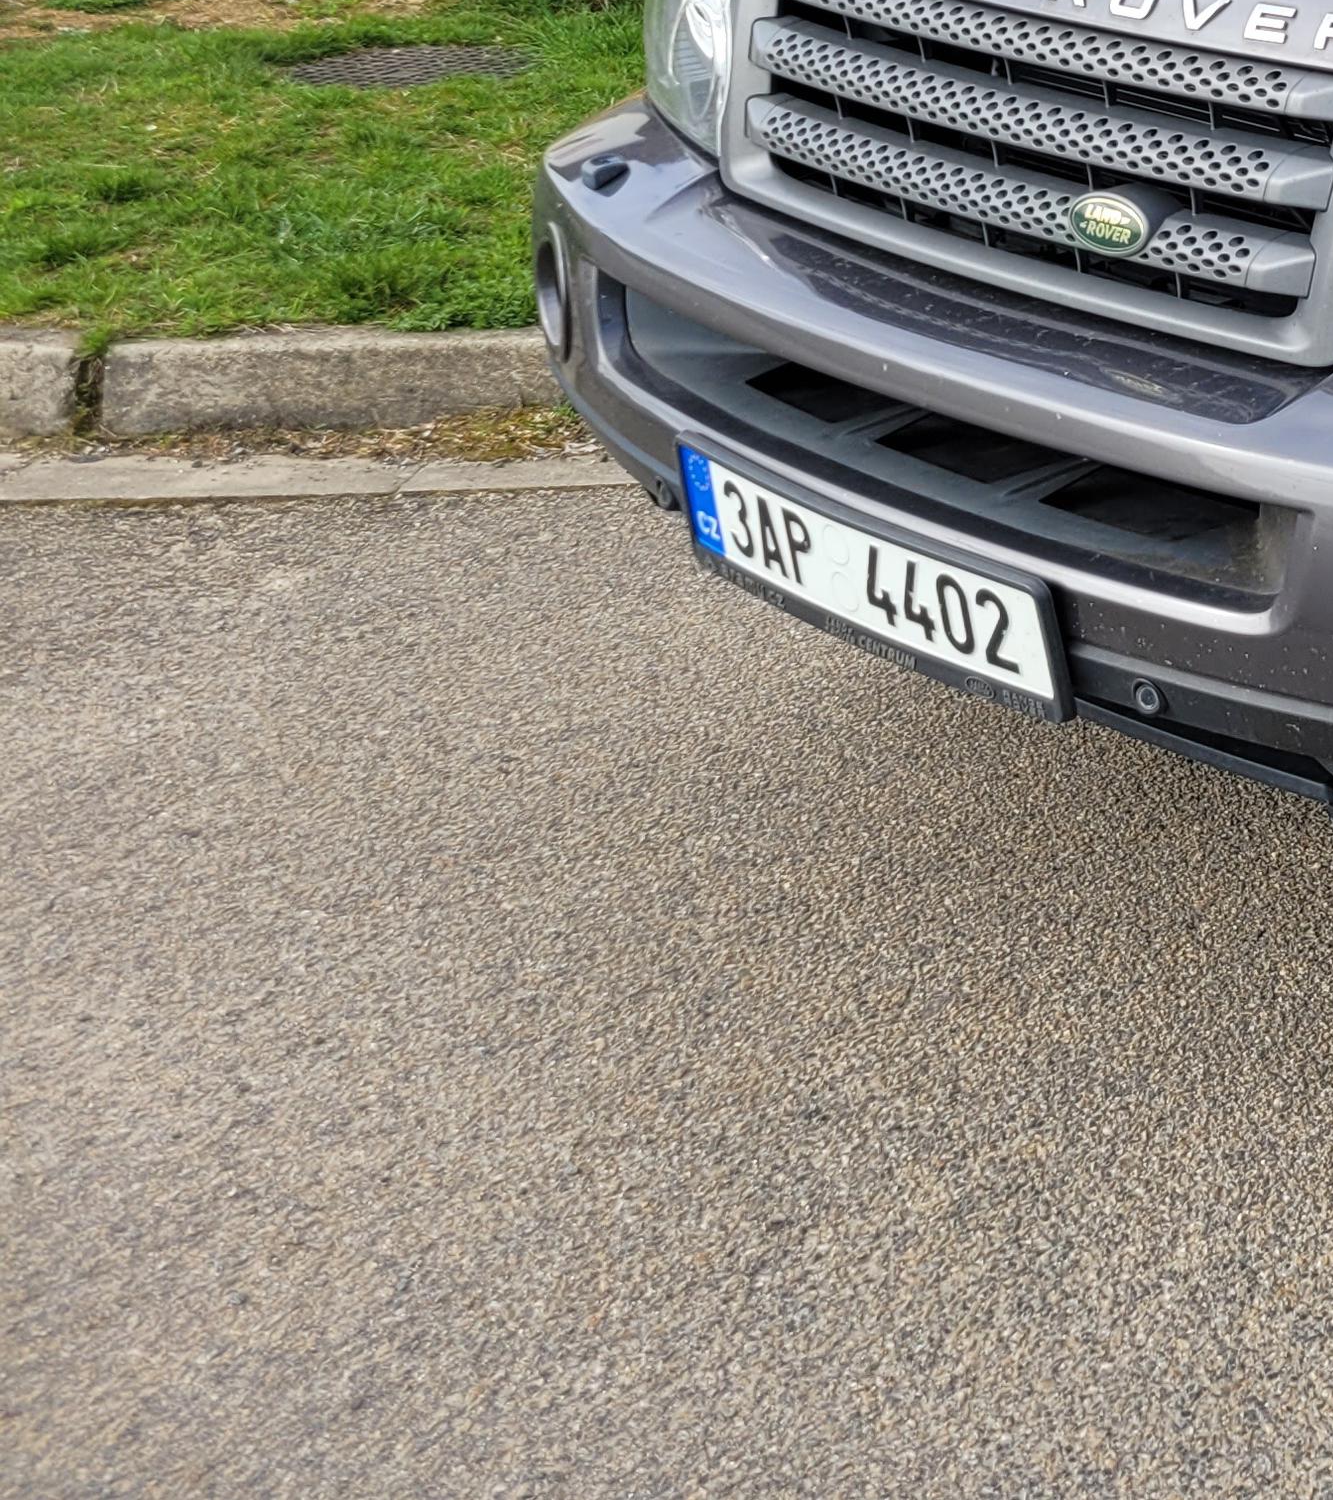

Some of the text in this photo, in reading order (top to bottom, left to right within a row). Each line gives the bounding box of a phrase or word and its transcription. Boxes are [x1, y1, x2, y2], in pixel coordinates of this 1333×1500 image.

[1084, 203, 1122, 225] LAND
[1086, 220, 1132, 245] ROVER
[696, 510, 721, 541] CZ
[723, 479, 812, 586] 3AP
[865, 545, 1020, 675] 4402
